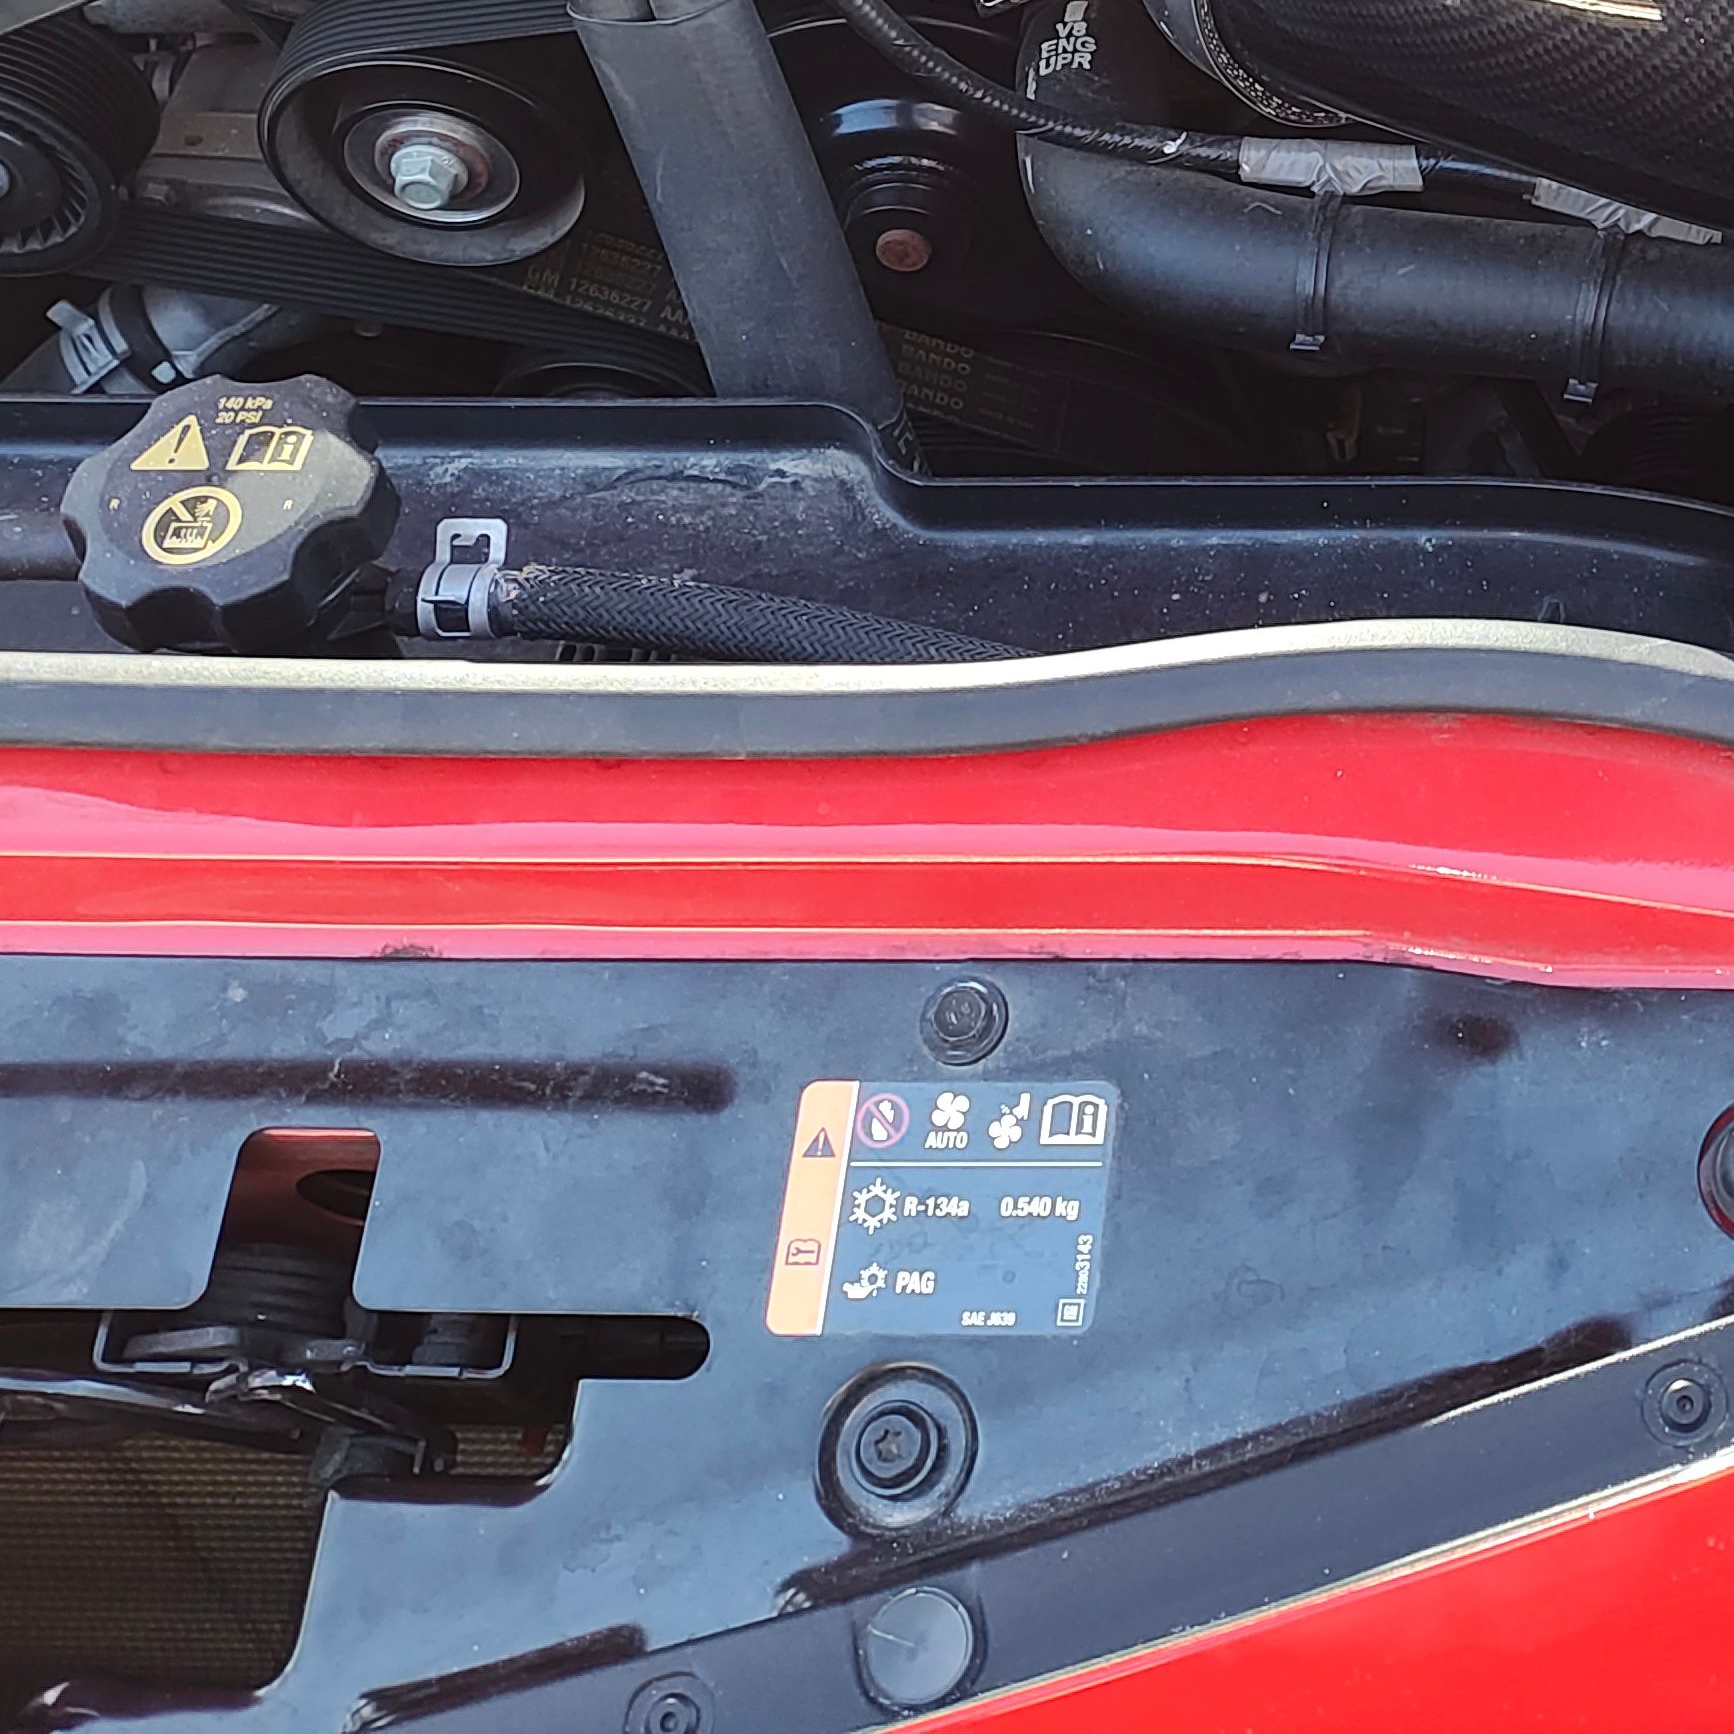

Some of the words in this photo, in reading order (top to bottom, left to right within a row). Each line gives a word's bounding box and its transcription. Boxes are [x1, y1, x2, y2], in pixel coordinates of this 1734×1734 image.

[1055, 21, 1088, 38] V8
[1040, 36, 1098, 59] ENG
[1038, 52, 1092, 77] UPR
[527, 265, 561, 293] GM
[568, 276, 653, 313] 12636227
[901, 344, 971, 376] BANDO
[217, 396, 242, 410] 140
[245, 396, 273, 410] kPa
[215, 411, 234, 424] 20
[235, 410, 263, 424] PSI
[924, 1131, 969, 1150] AUTO
[902, 1196, 970, 1218] R-134a
[999, 1196, 1052, 1218] 0.540
[1055, 1196, 1080, 1222] kg
[894, 1270, 936, 1295] PAG
[961, 1310, 986, 1327] SAE
